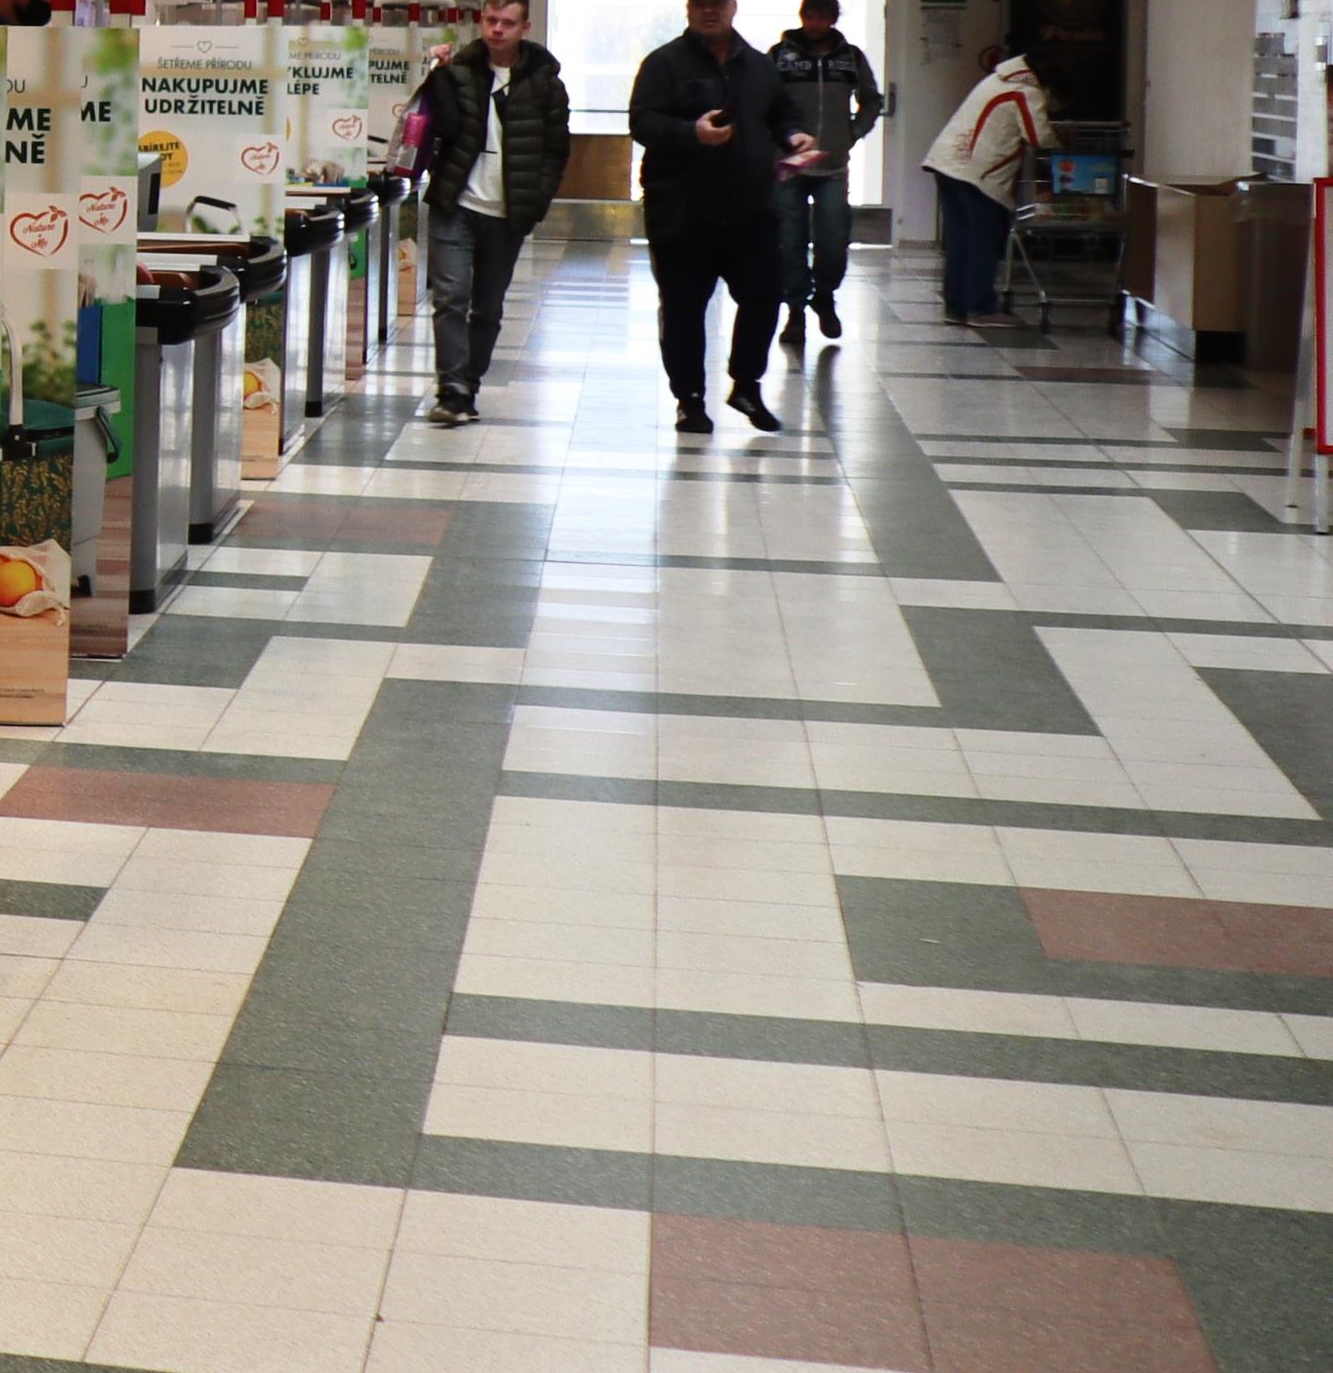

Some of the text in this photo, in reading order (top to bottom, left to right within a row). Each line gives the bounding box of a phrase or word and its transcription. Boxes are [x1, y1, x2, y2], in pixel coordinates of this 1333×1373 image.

[157, 56, 252, 70] ŠETŘEME PŘÍRODU
[287, 66, 354, 80] KLUJME
[141, 77, 268, 94] NAKUPUJME
[287, 79, 320, 95] LÉPE
[144, 94, 265, 115] UDRŽITELNĚ
[6, 108, 51, 131] ME
[6, 133, 45, 164] NĚ
[23, 220, 56, 234] Nature
[31, 236, 49, 248] Me
